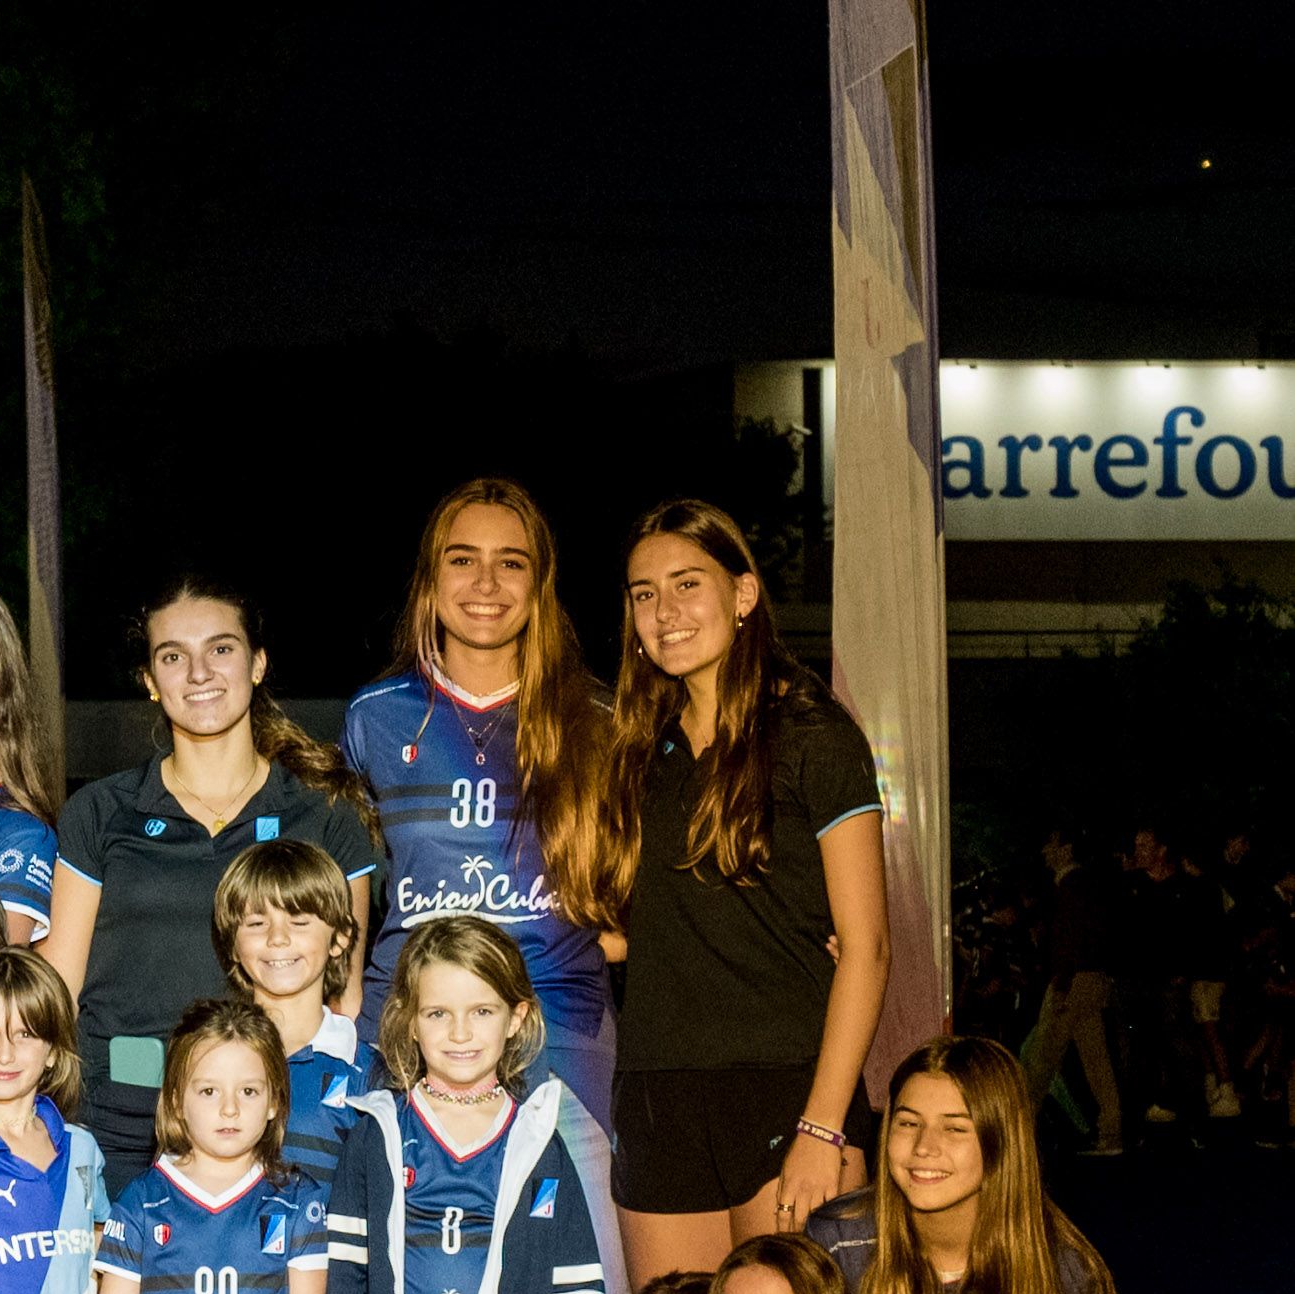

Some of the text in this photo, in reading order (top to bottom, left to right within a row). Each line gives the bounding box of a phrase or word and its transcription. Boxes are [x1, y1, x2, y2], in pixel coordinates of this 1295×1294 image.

[942, 405, 1295, 500] arrefou
[450, 778, 497, 829] 38
[398, 876, 484, 912] Enjoy
